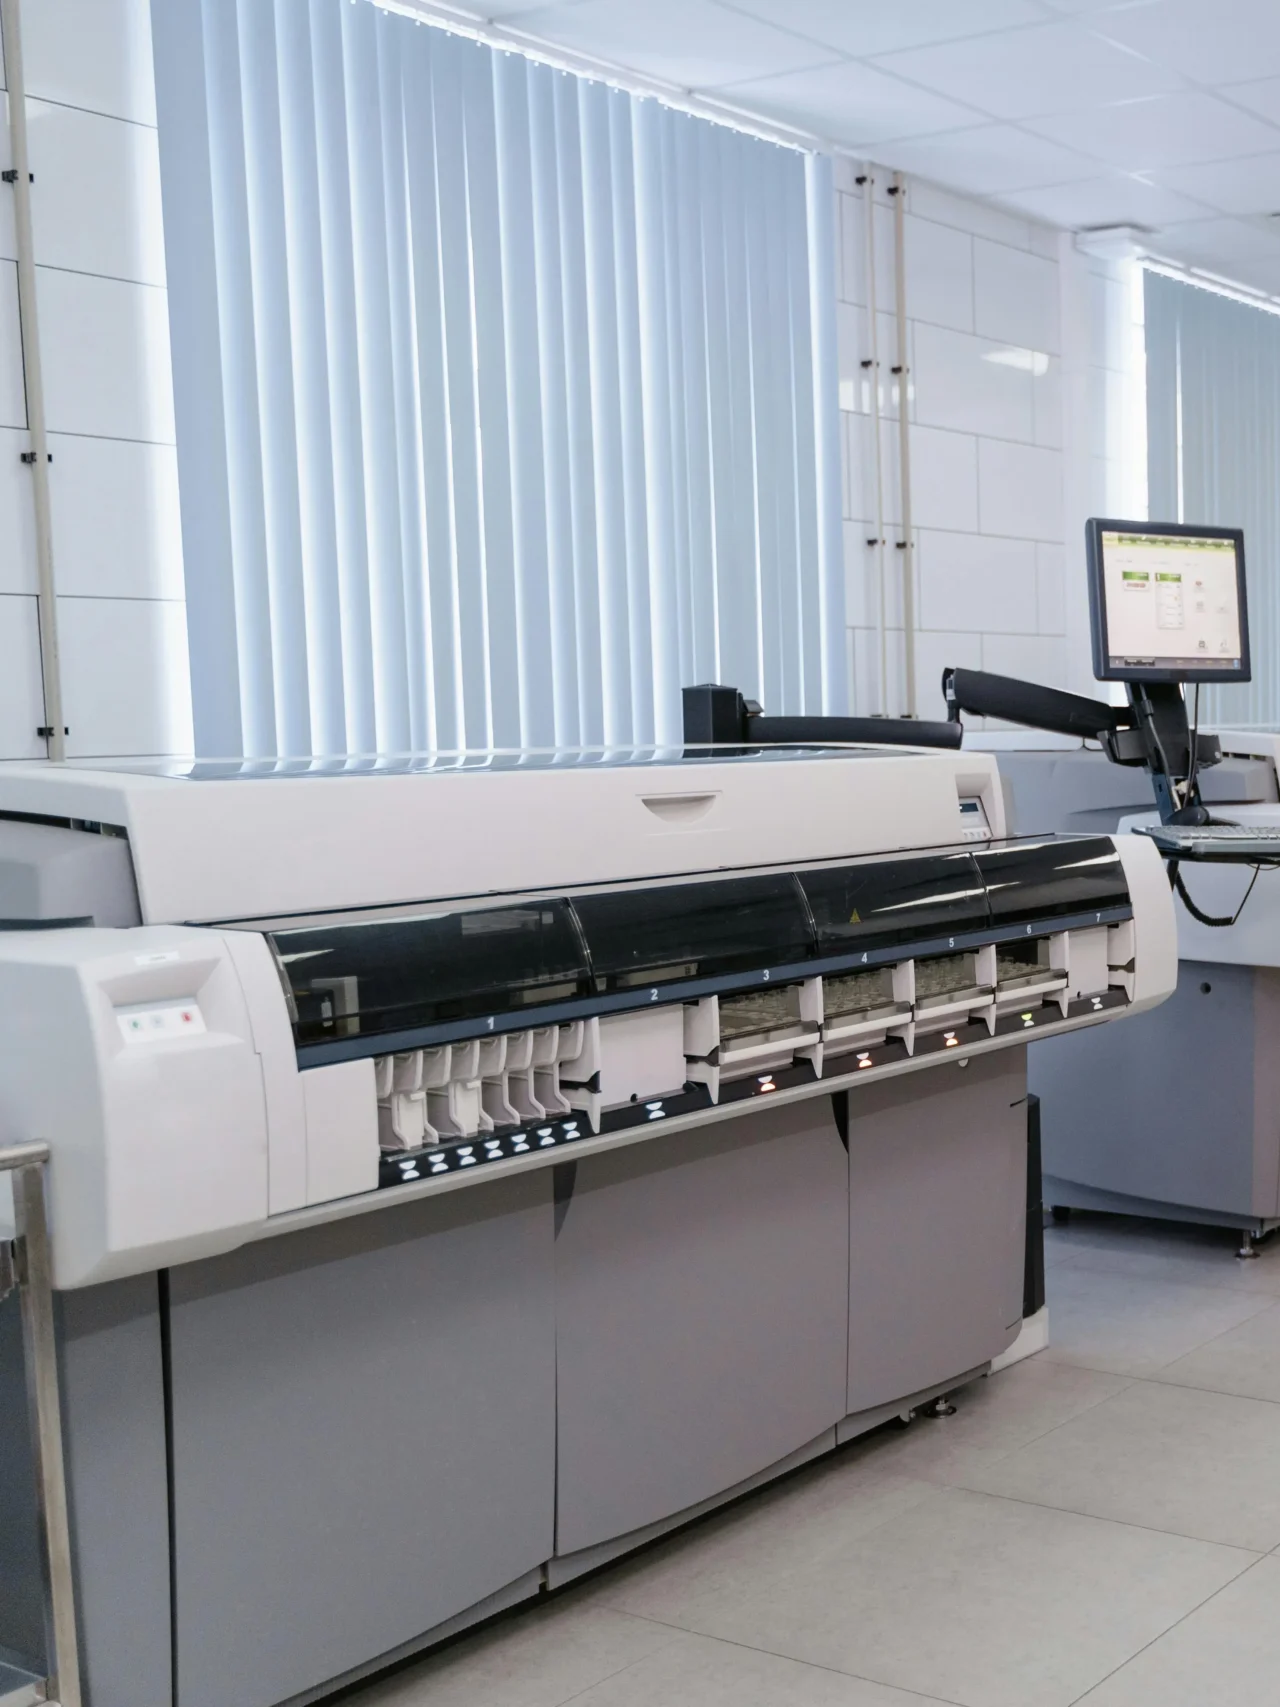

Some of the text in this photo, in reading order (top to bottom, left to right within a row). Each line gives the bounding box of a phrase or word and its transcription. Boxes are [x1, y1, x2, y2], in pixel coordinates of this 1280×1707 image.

[487, 1016, 494, 1030] 1
[650, 988, 659, 1001] 2
[763, 969, 770, 981] 3
[861, 952, 868, 964] 4
[948, 937, 955, 948] 5
[1026, 924, 1032, 935] 6
